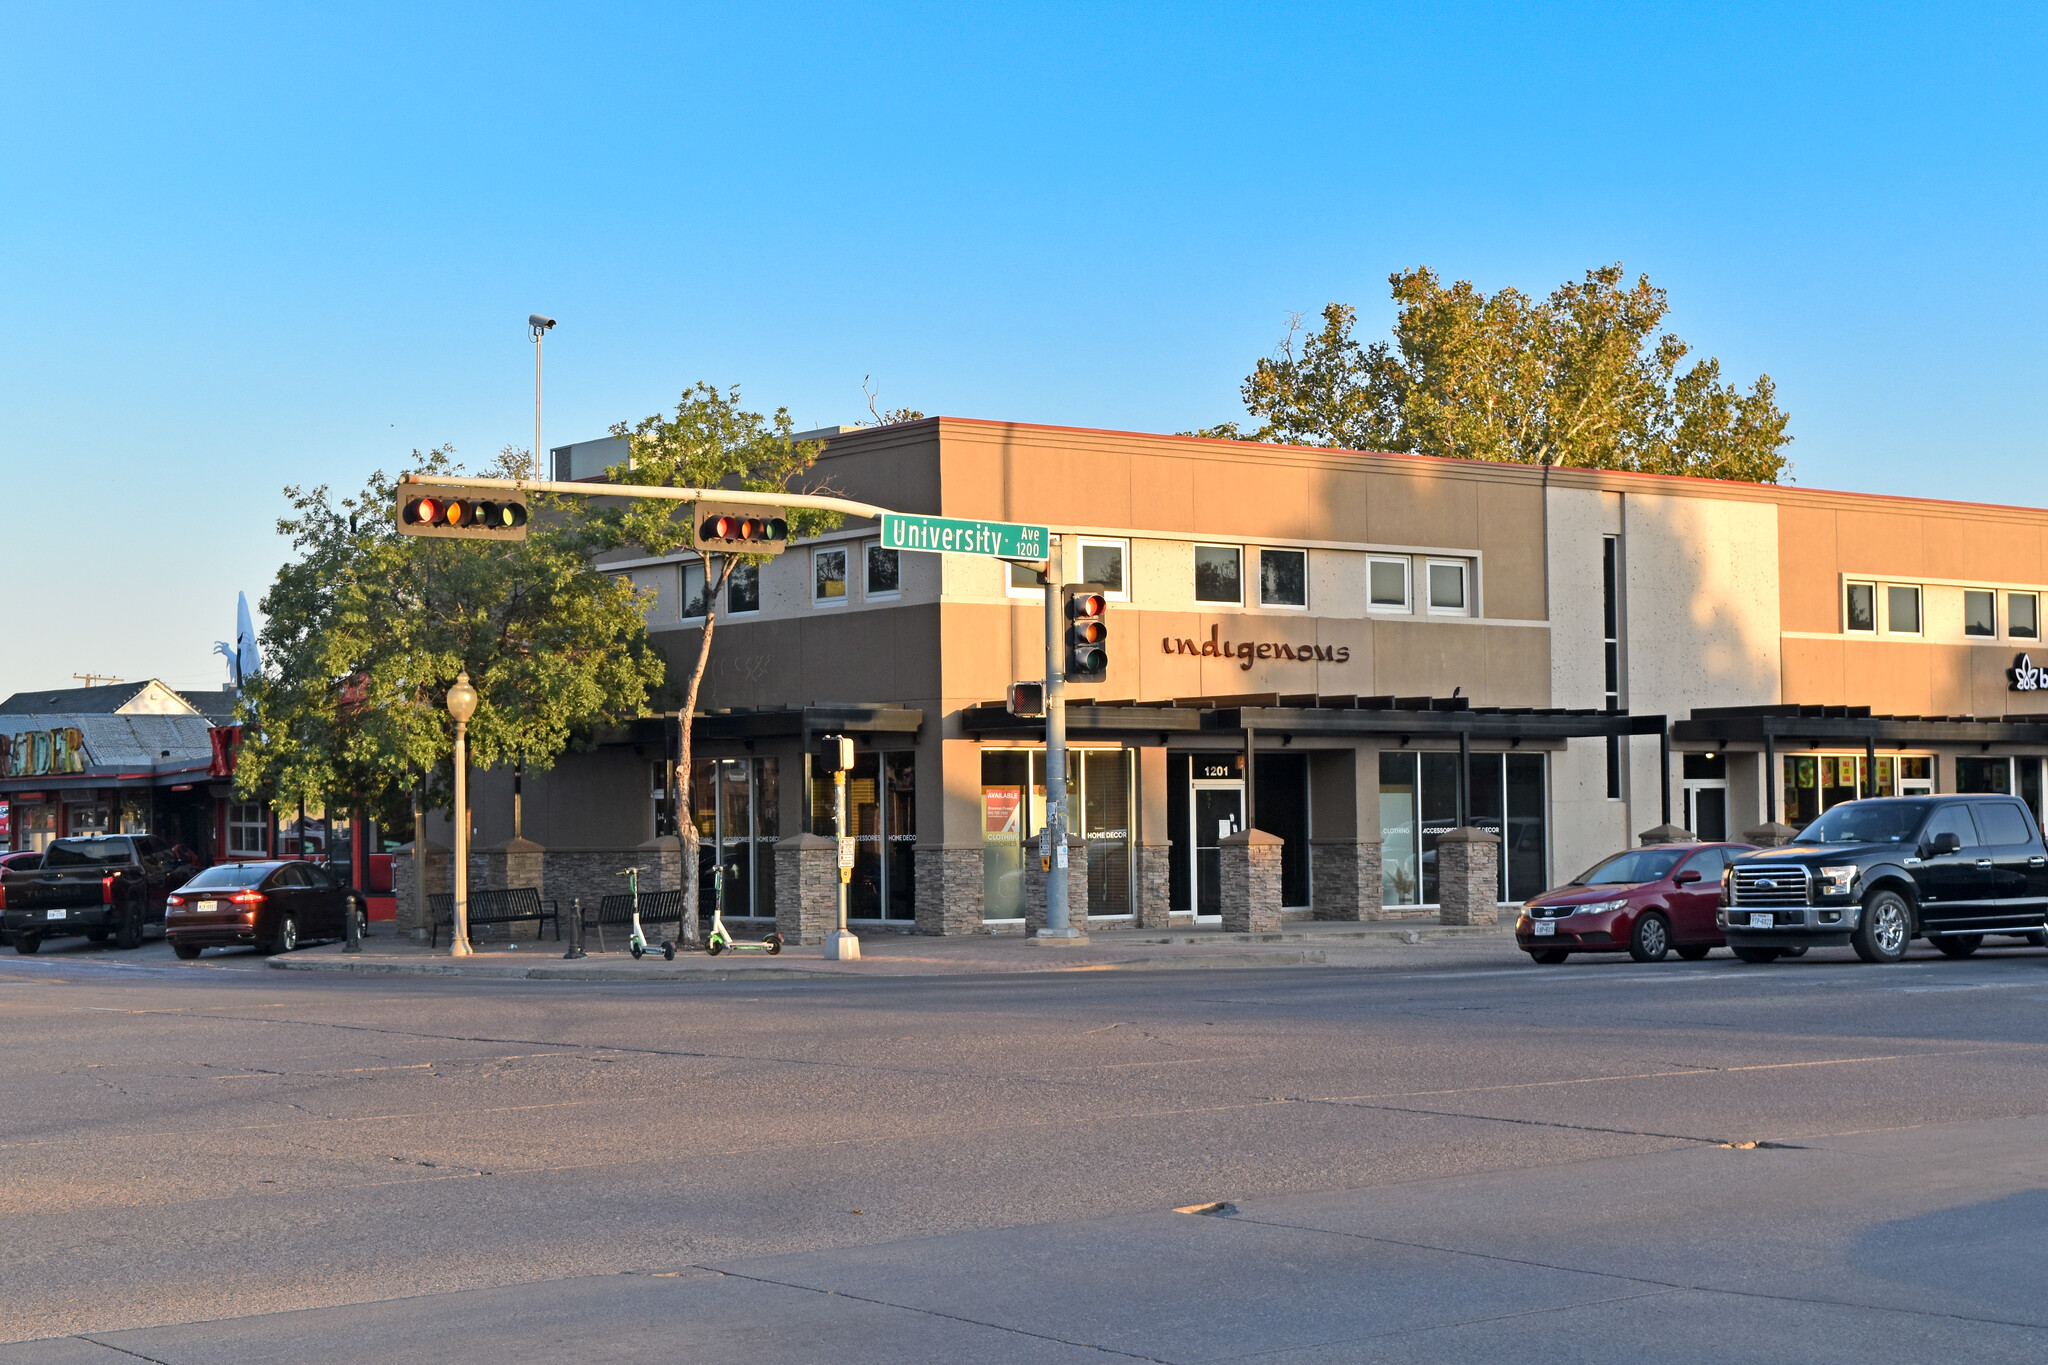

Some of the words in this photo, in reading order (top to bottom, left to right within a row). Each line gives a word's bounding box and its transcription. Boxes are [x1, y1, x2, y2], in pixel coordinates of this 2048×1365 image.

[893, 519, 1002, 555] University
[1021, 526, 1040, 541] Ave
[1016, 542, 1040, 557] 1200
[1162, 623, 1350, 671] indigenous
[1204, 766, 1229, 776] 1201
[987, 833, 1020, 841] CLOTHING
[1105, 831, 1127, 839] DECOR
